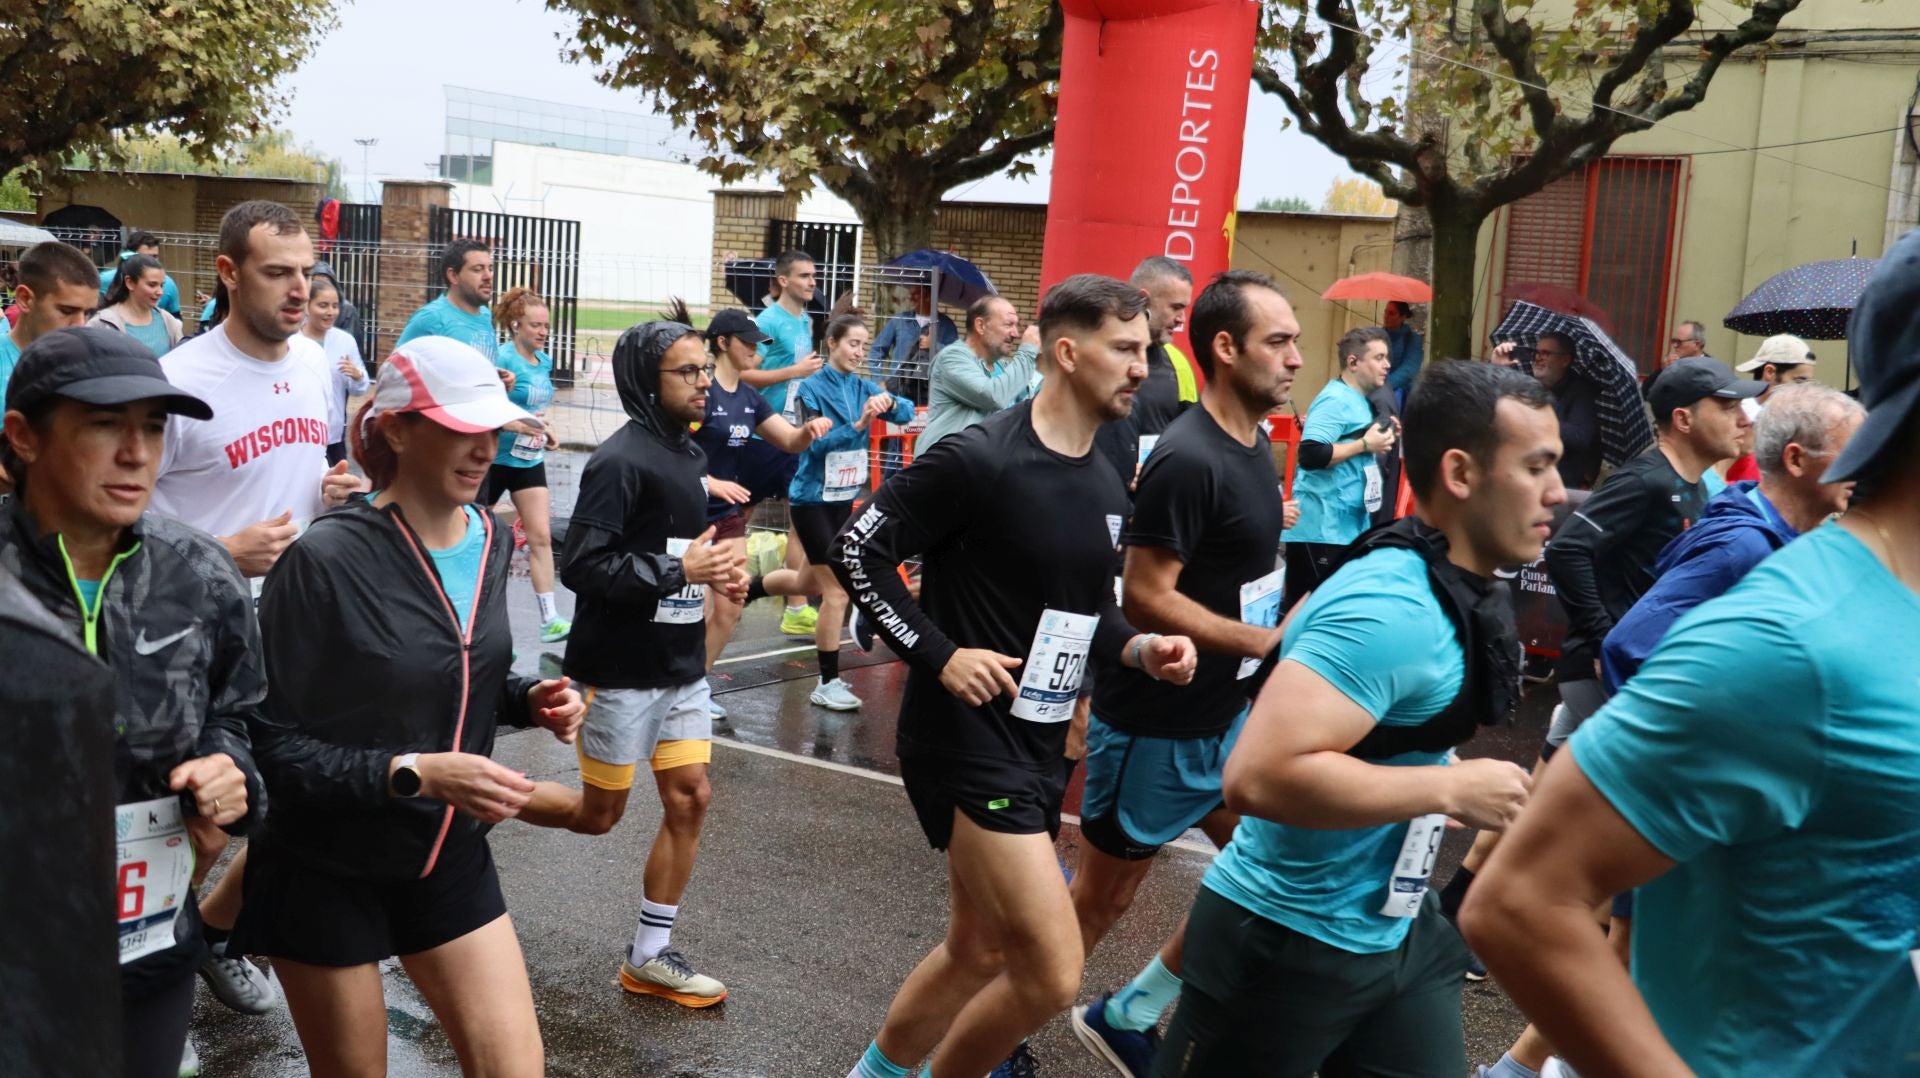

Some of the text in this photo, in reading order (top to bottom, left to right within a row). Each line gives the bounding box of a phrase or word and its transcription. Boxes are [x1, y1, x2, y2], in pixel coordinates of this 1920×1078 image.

[1164, 48, 1219, 261] DEPORTES
[729, 424, 750, 439] 200
[838, 466, 857, 486] 772
[853, 502, 884, 533] 10K
[1520, 568, 1548, 582] Cuna
[117, 861, 148, 920] 6
